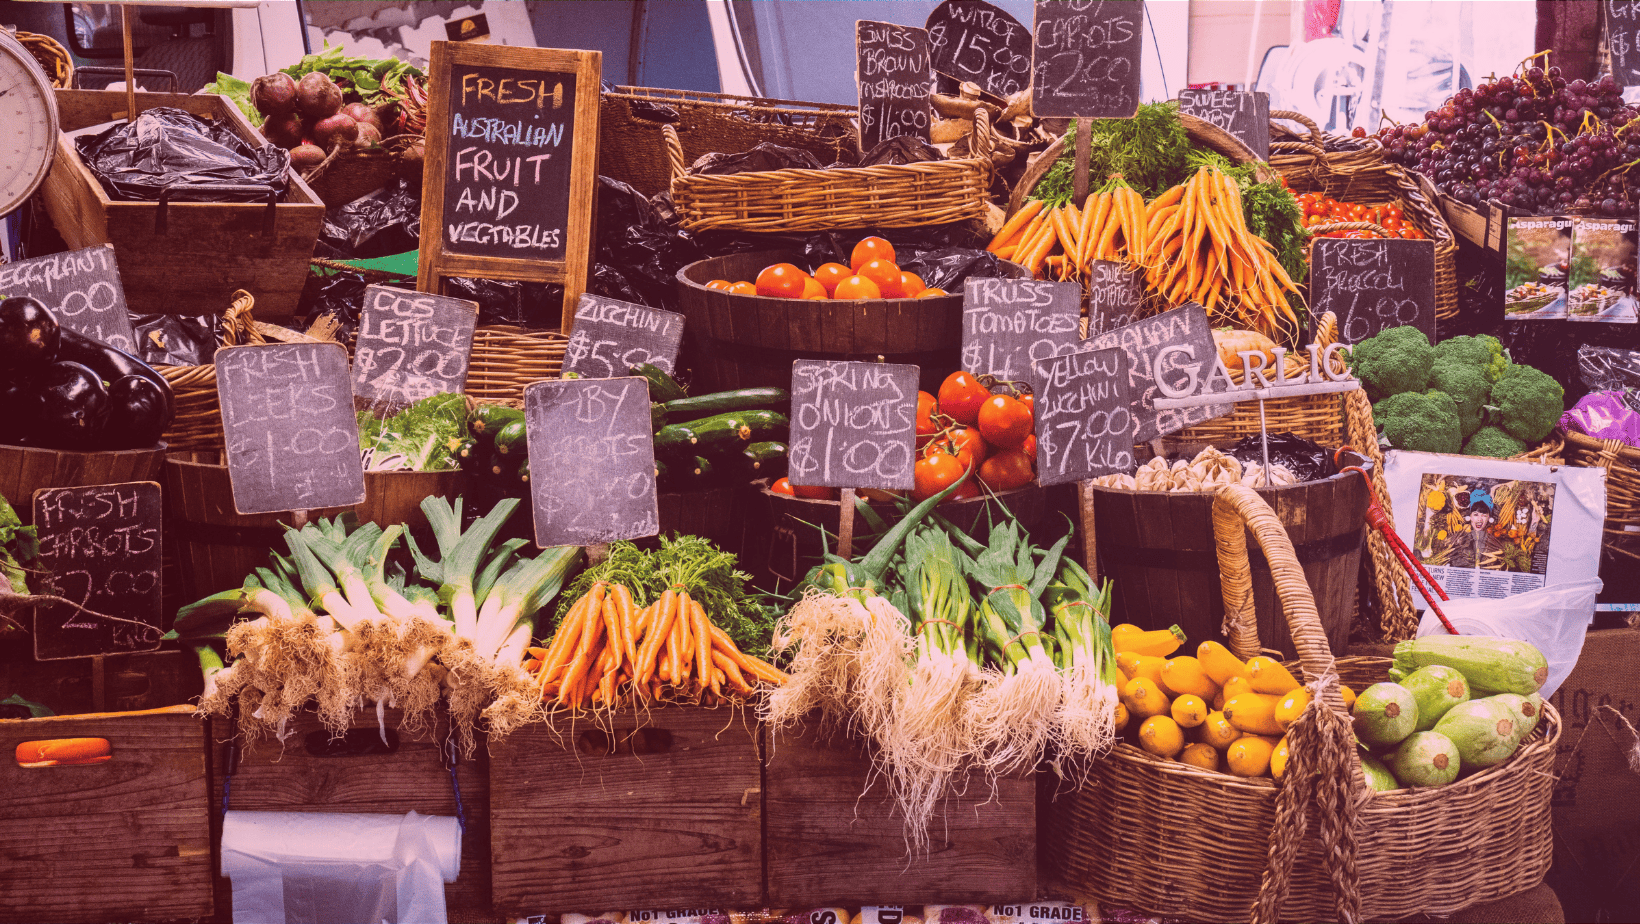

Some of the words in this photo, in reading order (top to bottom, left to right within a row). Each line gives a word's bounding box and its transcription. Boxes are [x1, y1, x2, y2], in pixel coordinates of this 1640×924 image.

[861, 48, 922, 76] BROWN
[462, 73, 563, 109] FRESH
[1180, 91, 1244, 112] SWEET
[453, 113, 564, 147] AUSTRALIAN
[456, 146, 551, 186] FRUIT
[455, 186, 519, 220] AND
[0, 250, 107, 292] EGGPLANT
[1321, 240, 1388, 266] FRESH
[374, 291, 435, 317] COS
[967, 278, 1054, 307] TRUSS
[360, 312, 472, 350] LETTUCE
[964, 307, 1080, 335] TOMATOES
[221, 347, 320, 383] FRESH
[357, 346, 467, 389] $2.00
[1038, 353, 1118, 398] YELLOW
[1153, 343, 1353, 398] GARLIC
[797, 361, 904, 408] SPRING
[799, 399, 914, 435] ONIONS
[1039, 406, 1131, 474] $7.00
[790, 437, 911, 482] $1.00
[38, 489, 140, 527] FRESH
[630, 909, 660, 922] No1
[993, 904, 1022, 917] No1
[1029, 906, 1082, 922] GRADE
